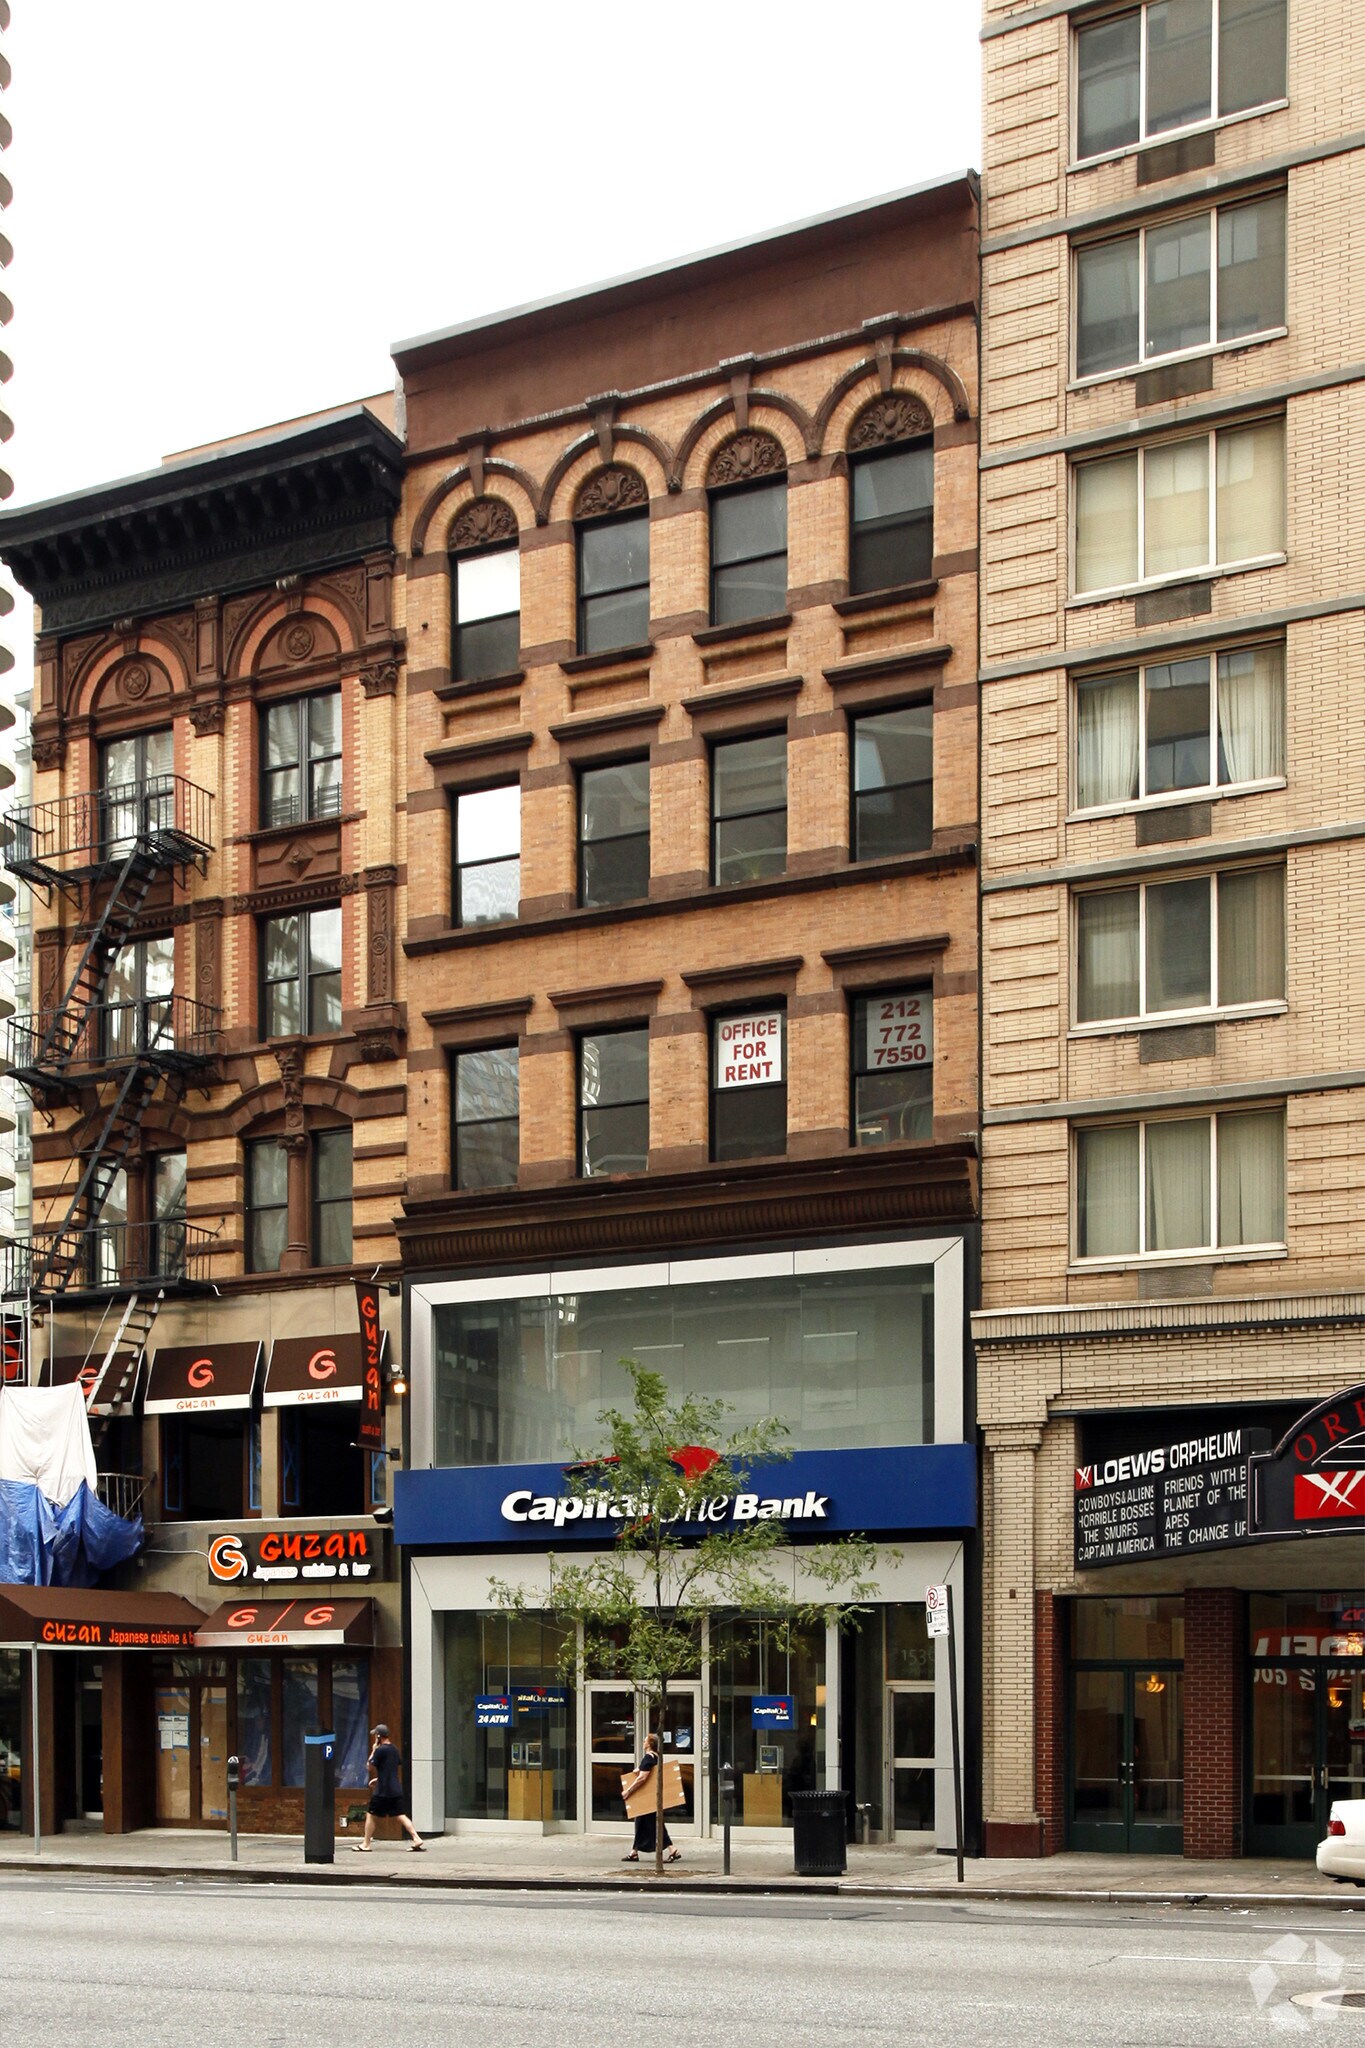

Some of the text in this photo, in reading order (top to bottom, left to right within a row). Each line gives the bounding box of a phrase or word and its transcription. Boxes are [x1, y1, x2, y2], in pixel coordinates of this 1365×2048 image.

[880, 1000, 920, 1020] 212
[721, 1019, 778, 1042] OFFICE
[879, 1023, 921, 1044] 772
[733, 1041, 767, 1061] FOR
[874, 1044, 926, 1065] 7550
[725, 1061, 773, 1082] RENT
[1094, 1429, 1241, 1487] LOEWS ORPHEUM
[1164, 1474, 1204, 1495] FRIENDS
[1210, 1469, 1236, 1486] WITH
[733, 1491, 829, 1520] Bank
[1164, 1483, 1247, 1513] PLANET OF THE
[1078, 1502, 1154, 1528] HORRIBLE BOSSES
[1165, 1513, 1190, 1530] APES
[1084, 1522, 1138, 1544] THE SMURFS
[1165, 1531, 1182, 1548] THE
[1189, 1524, 1228, 1544] CHANGE
[1078, 1536, 1154, 1561] CAPTAIN AMERICA
[253, 1562, 371, 1581] Japanese cuisine & bar
[109, 1629, 149, 1646] Japanese
[151, 1631, 179, 1644] cuisine
[182, 1634, 187, 1644] &
[477, 1715, 510, 1723] 24 ATM
